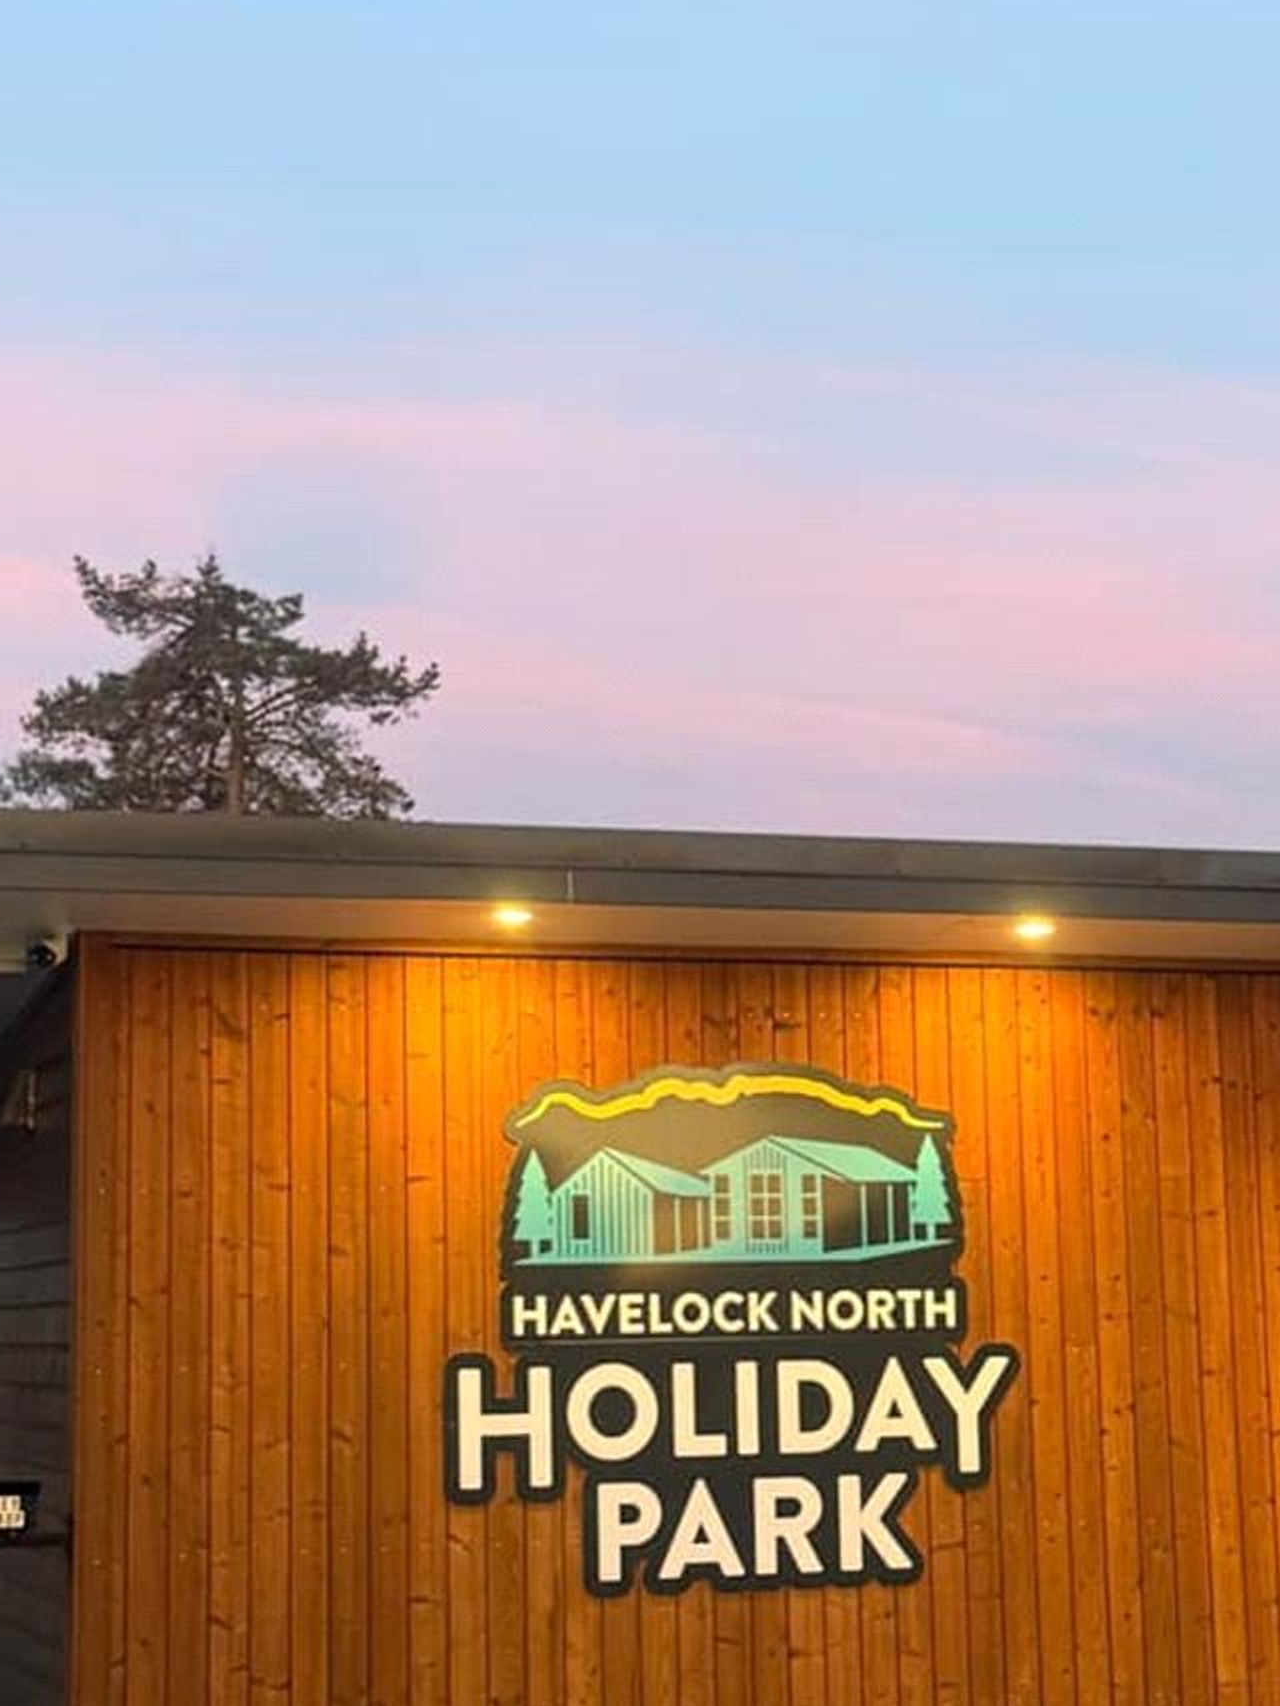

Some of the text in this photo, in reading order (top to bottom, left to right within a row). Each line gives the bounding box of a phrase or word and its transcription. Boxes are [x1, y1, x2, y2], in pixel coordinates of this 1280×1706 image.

[512, 1289, 957, 1336] HAVELOCK NORTH
[458, 1356, 1010, 1490] HOLIDAY
[596, 1474, 913, 1582] PARK
